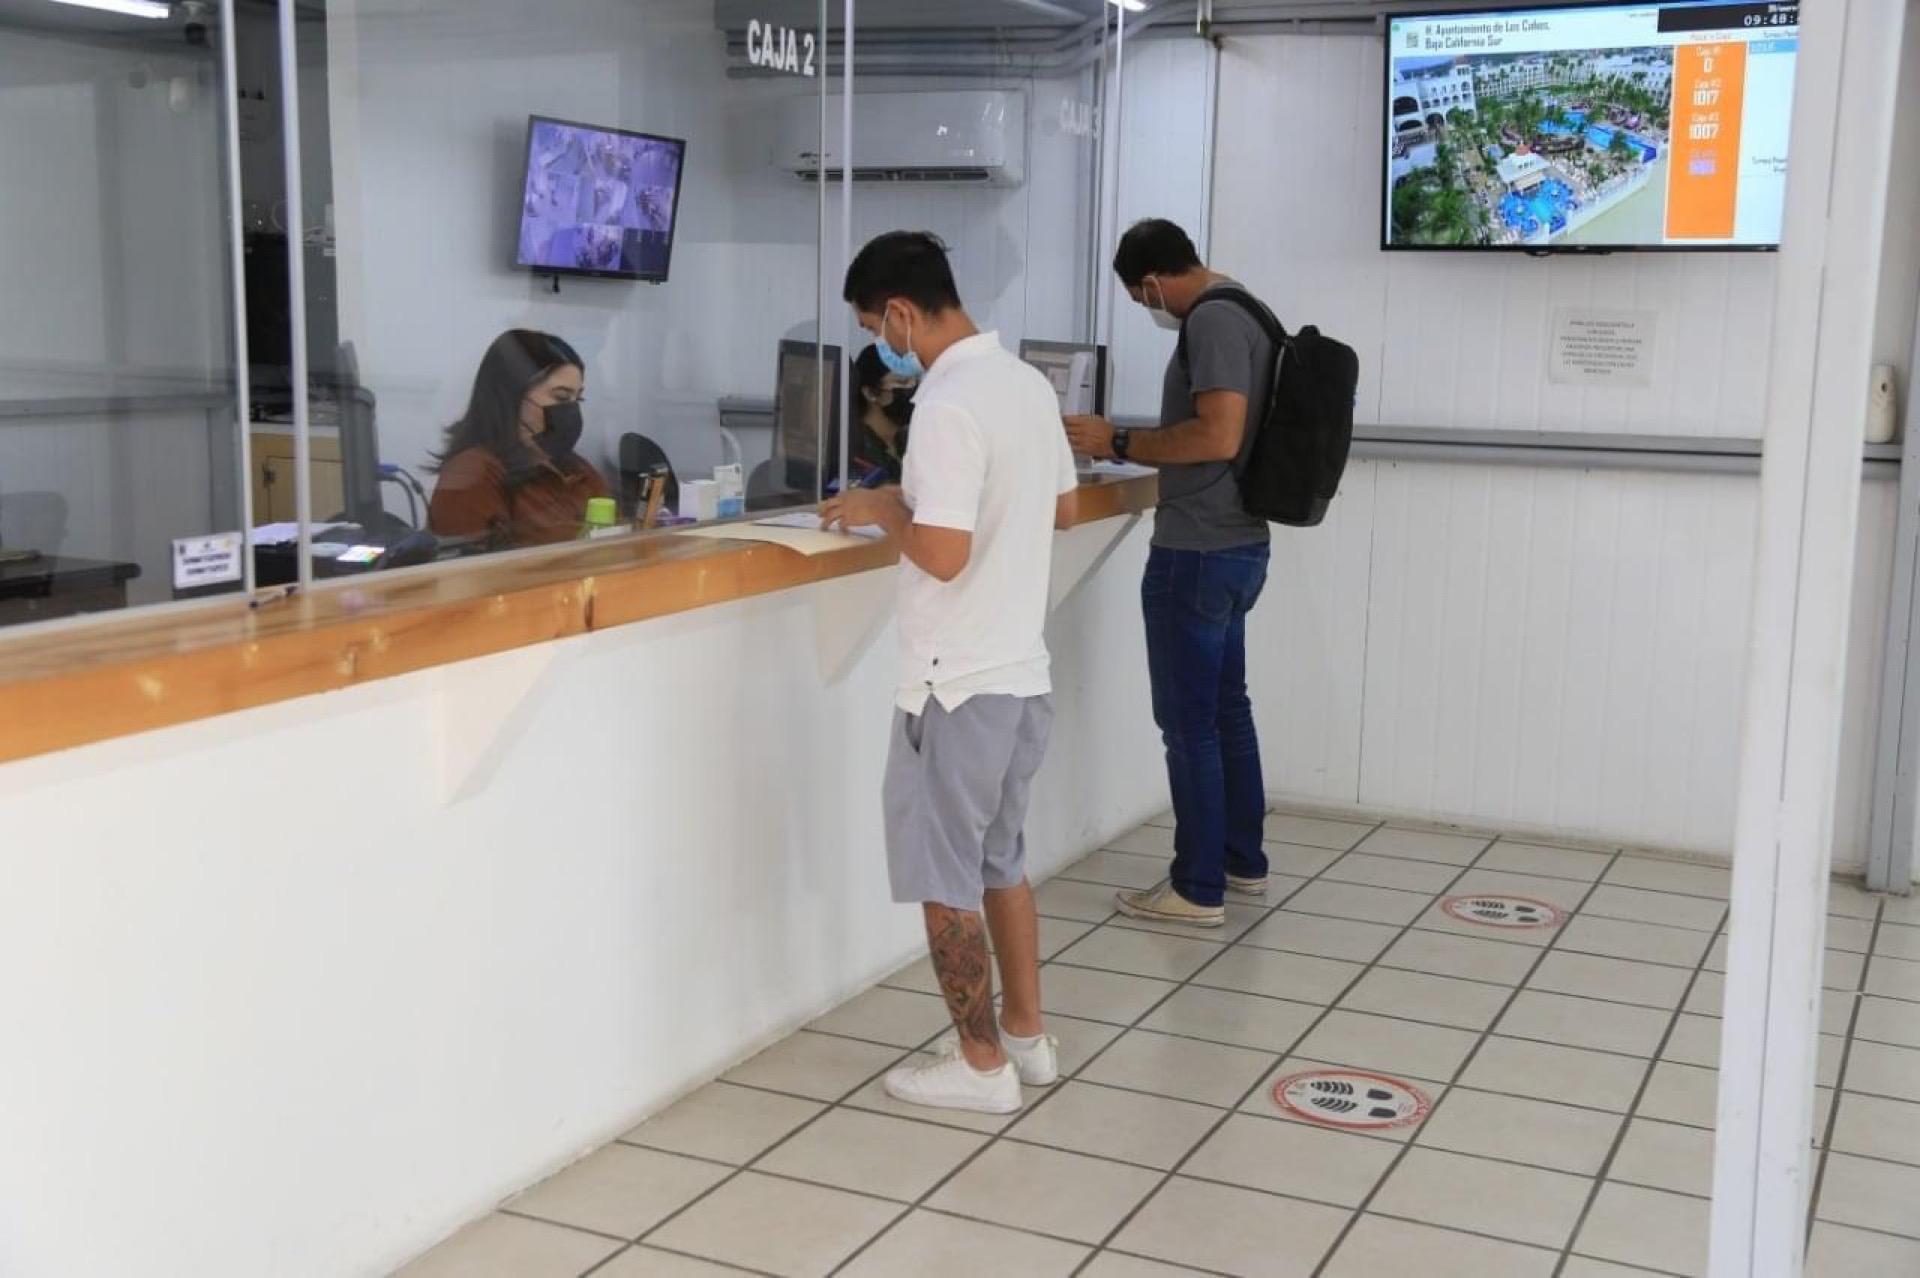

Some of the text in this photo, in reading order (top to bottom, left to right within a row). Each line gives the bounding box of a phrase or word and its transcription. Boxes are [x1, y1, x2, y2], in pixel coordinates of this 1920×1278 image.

[1436, 23, 1491, 36] Ayuntamiento
[1493, 22, 1503, 32] de
[1505, 20, 1520, 32] Los
[747, 19, 815, 76] CAJA 2
[1425, 34, 1503, 51] Baja California Sur
[1703, 57, 1712, 73] 0
